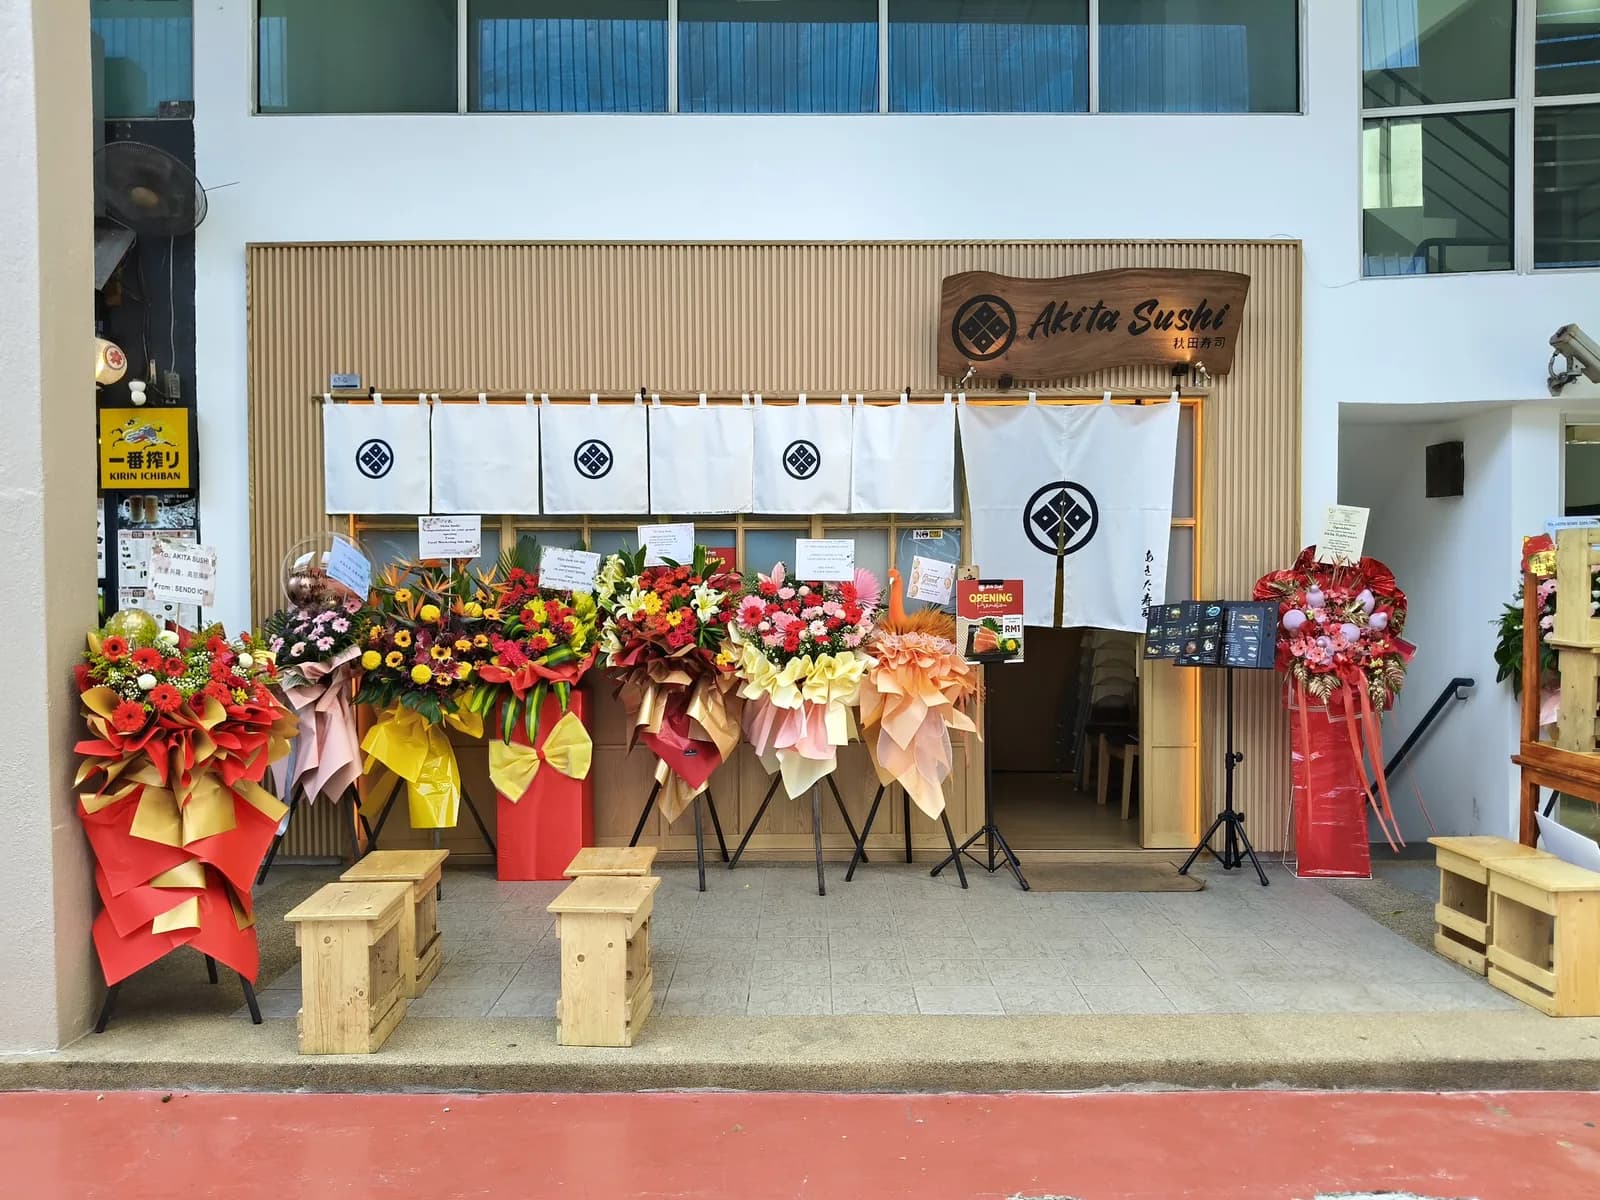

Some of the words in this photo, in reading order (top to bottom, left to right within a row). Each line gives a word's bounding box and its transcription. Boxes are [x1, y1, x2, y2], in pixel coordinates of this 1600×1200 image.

[1027, 300, 1120, 340] Akita
[1127, 298, 1230, 336] Sushi
[109, 451, 179, 469] 一番搾り
[109, 472, 137, 480] KIRIN
[140, 472, 181, 480] ICHIBAN
[172, 553, 191, 561] AKITA
[174, 585, 196, 594] SENDO
[969, 593, 1013, 603] OPENING
[1004, 625, 1020, 633] RM1
